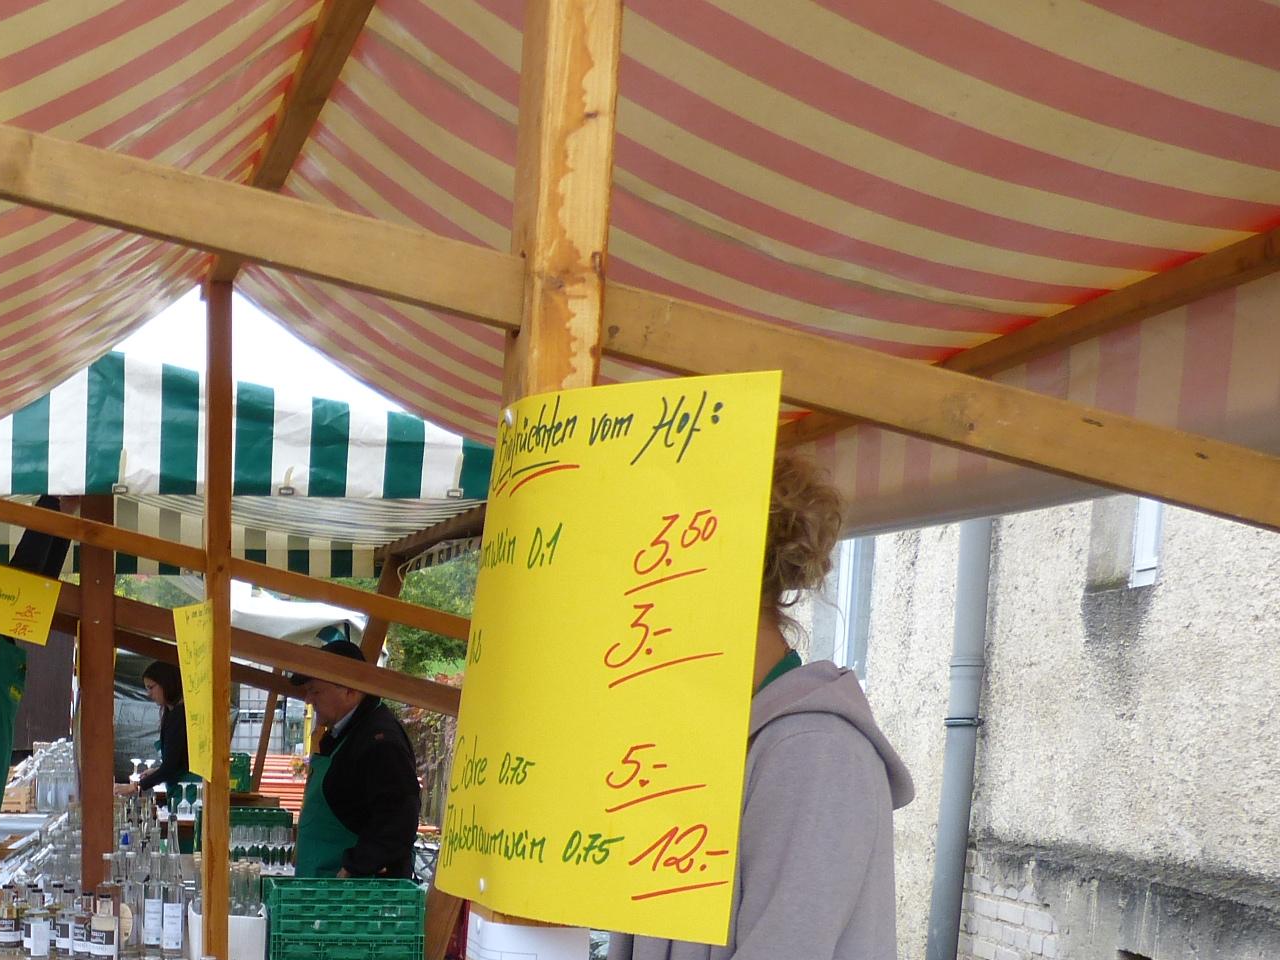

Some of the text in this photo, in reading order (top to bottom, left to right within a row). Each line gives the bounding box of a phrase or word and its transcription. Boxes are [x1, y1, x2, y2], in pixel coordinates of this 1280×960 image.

[589, 413, 634, 447] vom
[631, 391, 724, 466] Hof:
[527, 522, 563, 570] 0,1
[450, 735, 488, 792] Cidre
[498, 751, 535, 785] 0,75
[562, 829, 625, 866] 0,75
